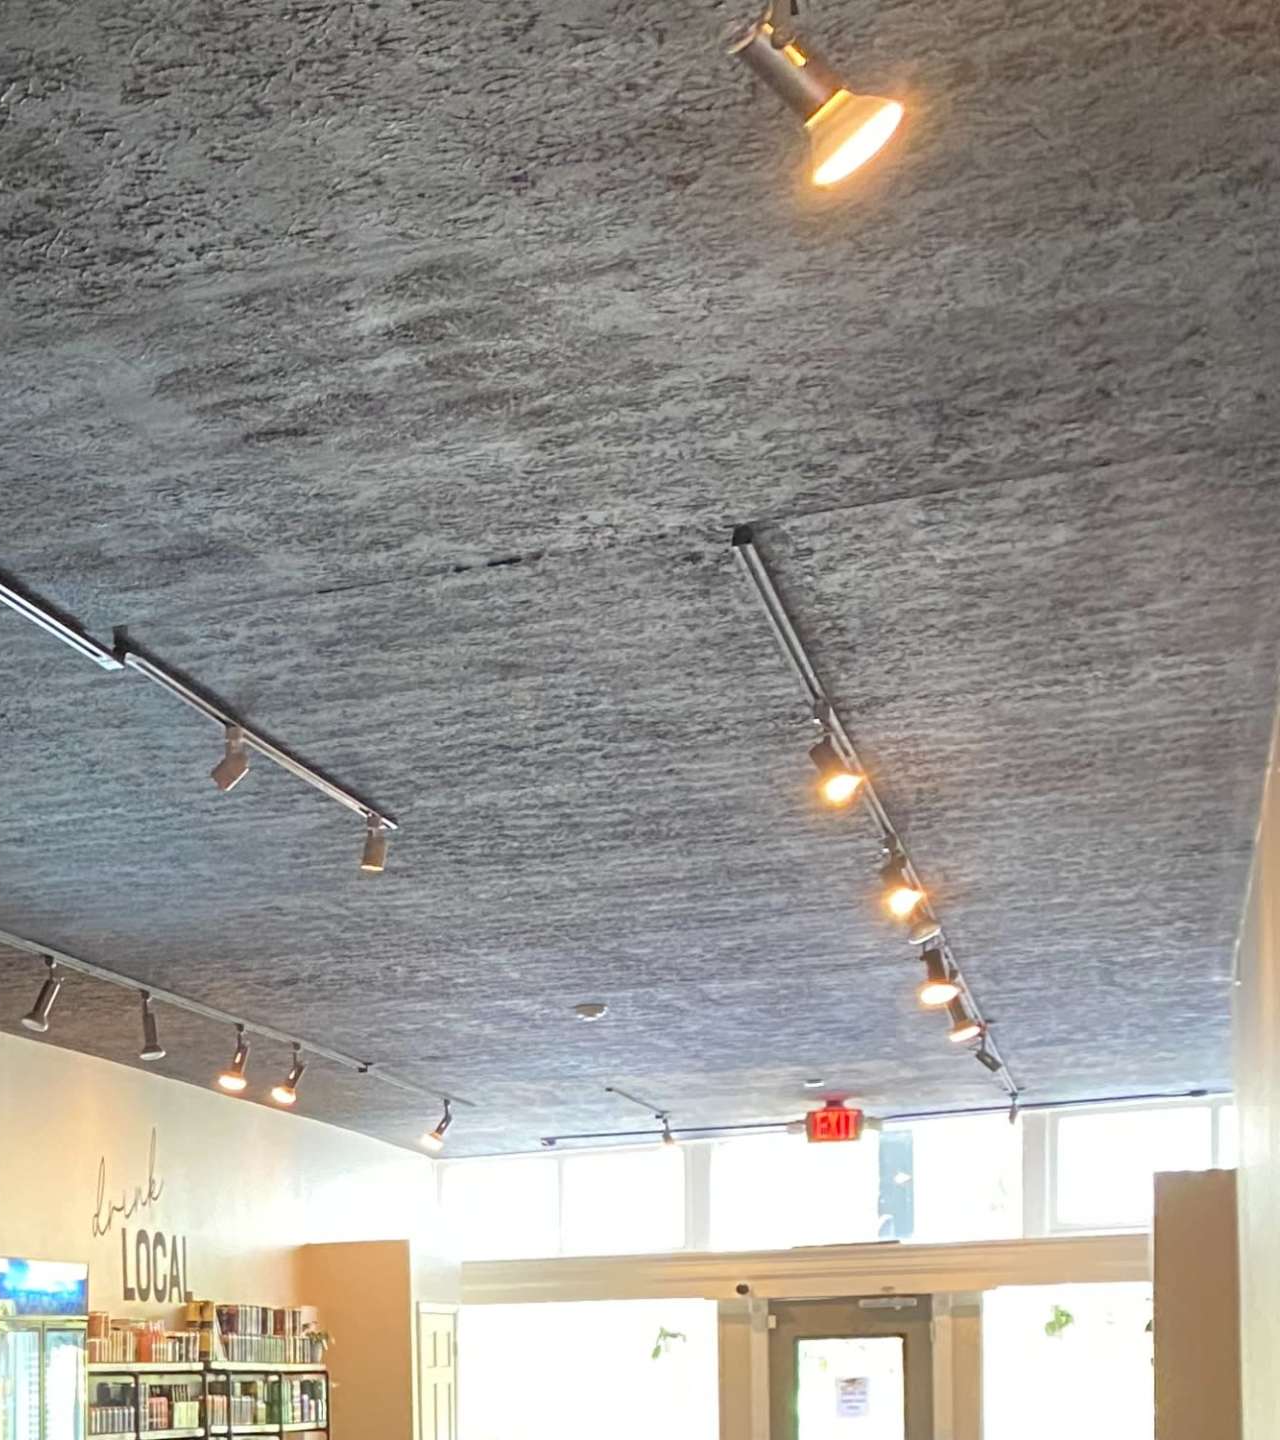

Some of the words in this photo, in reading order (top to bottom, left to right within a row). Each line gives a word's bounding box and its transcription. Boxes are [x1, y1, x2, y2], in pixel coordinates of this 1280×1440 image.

[815, 1110, 858, 1140] EXIT
[92, 1127, 164, 1238] drink
[121, 1227, 193, 1303] LOCAL
